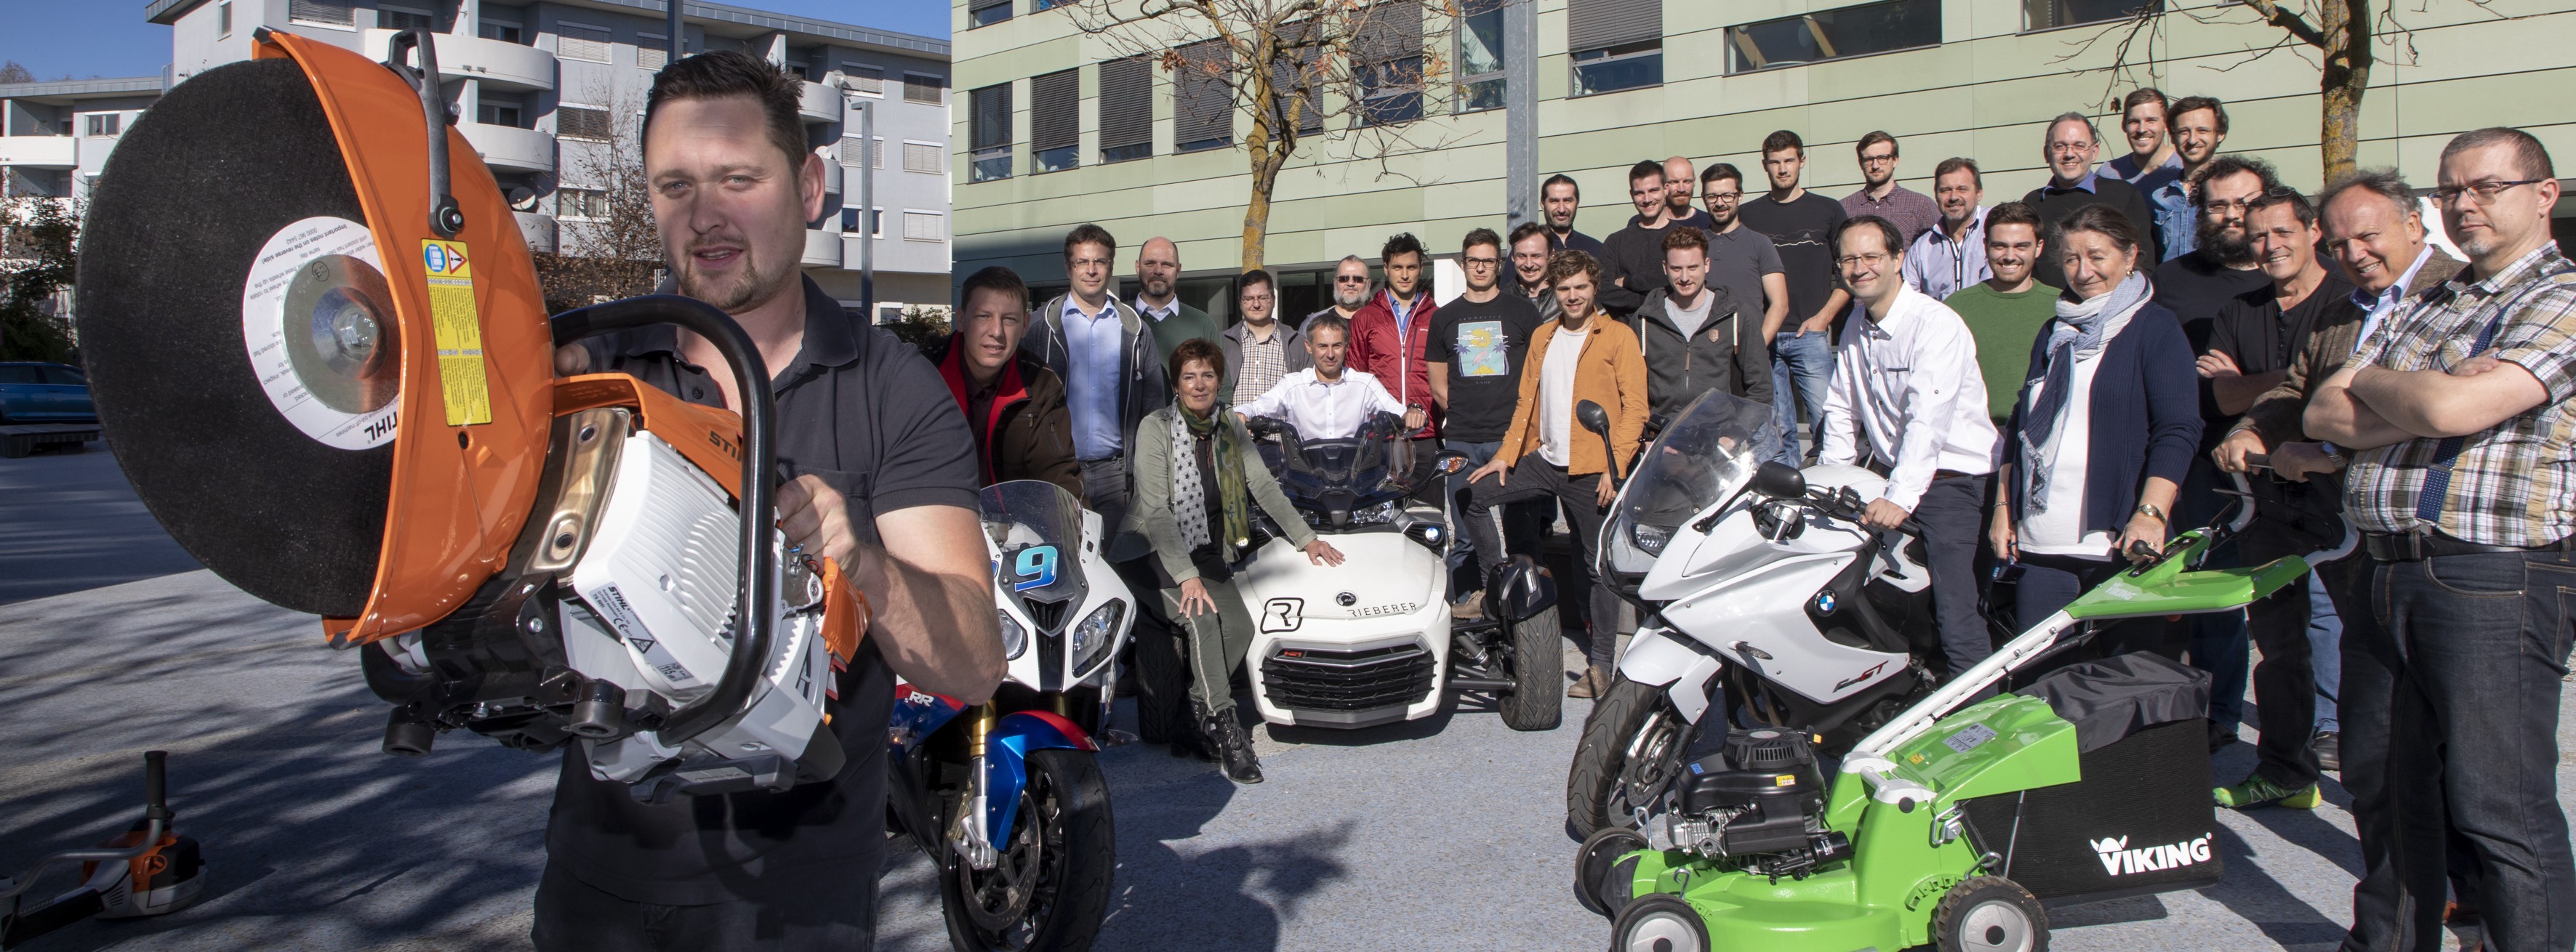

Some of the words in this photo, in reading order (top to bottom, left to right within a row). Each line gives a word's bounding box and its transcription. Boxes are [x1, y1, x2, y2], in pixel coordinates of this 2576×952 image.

[324, 224, 347, 239] Important
[310, 233, 324, 243] notes
[275, 246, 293, 258] reverse
[294, 242, 302, 251] the
[309, 246, 321, 255] same
[261, 253, 274, 265] side!
[269, 271, 284, 283] wheels
[269, 282, 281, 293] wheel
[250, 289, 263, 301] rotate
[261, 342, 276, 353] stored
[336, 424, 356, 437] machines
[364, 411, 398, 441] TIHL
[1014, 545, 1058, 592] 9
[608, 586, 628, 610] STIHL
[1347, 602, 1416, 617] RIEBERER
[2098, 837, 2212, 876] VIKING
